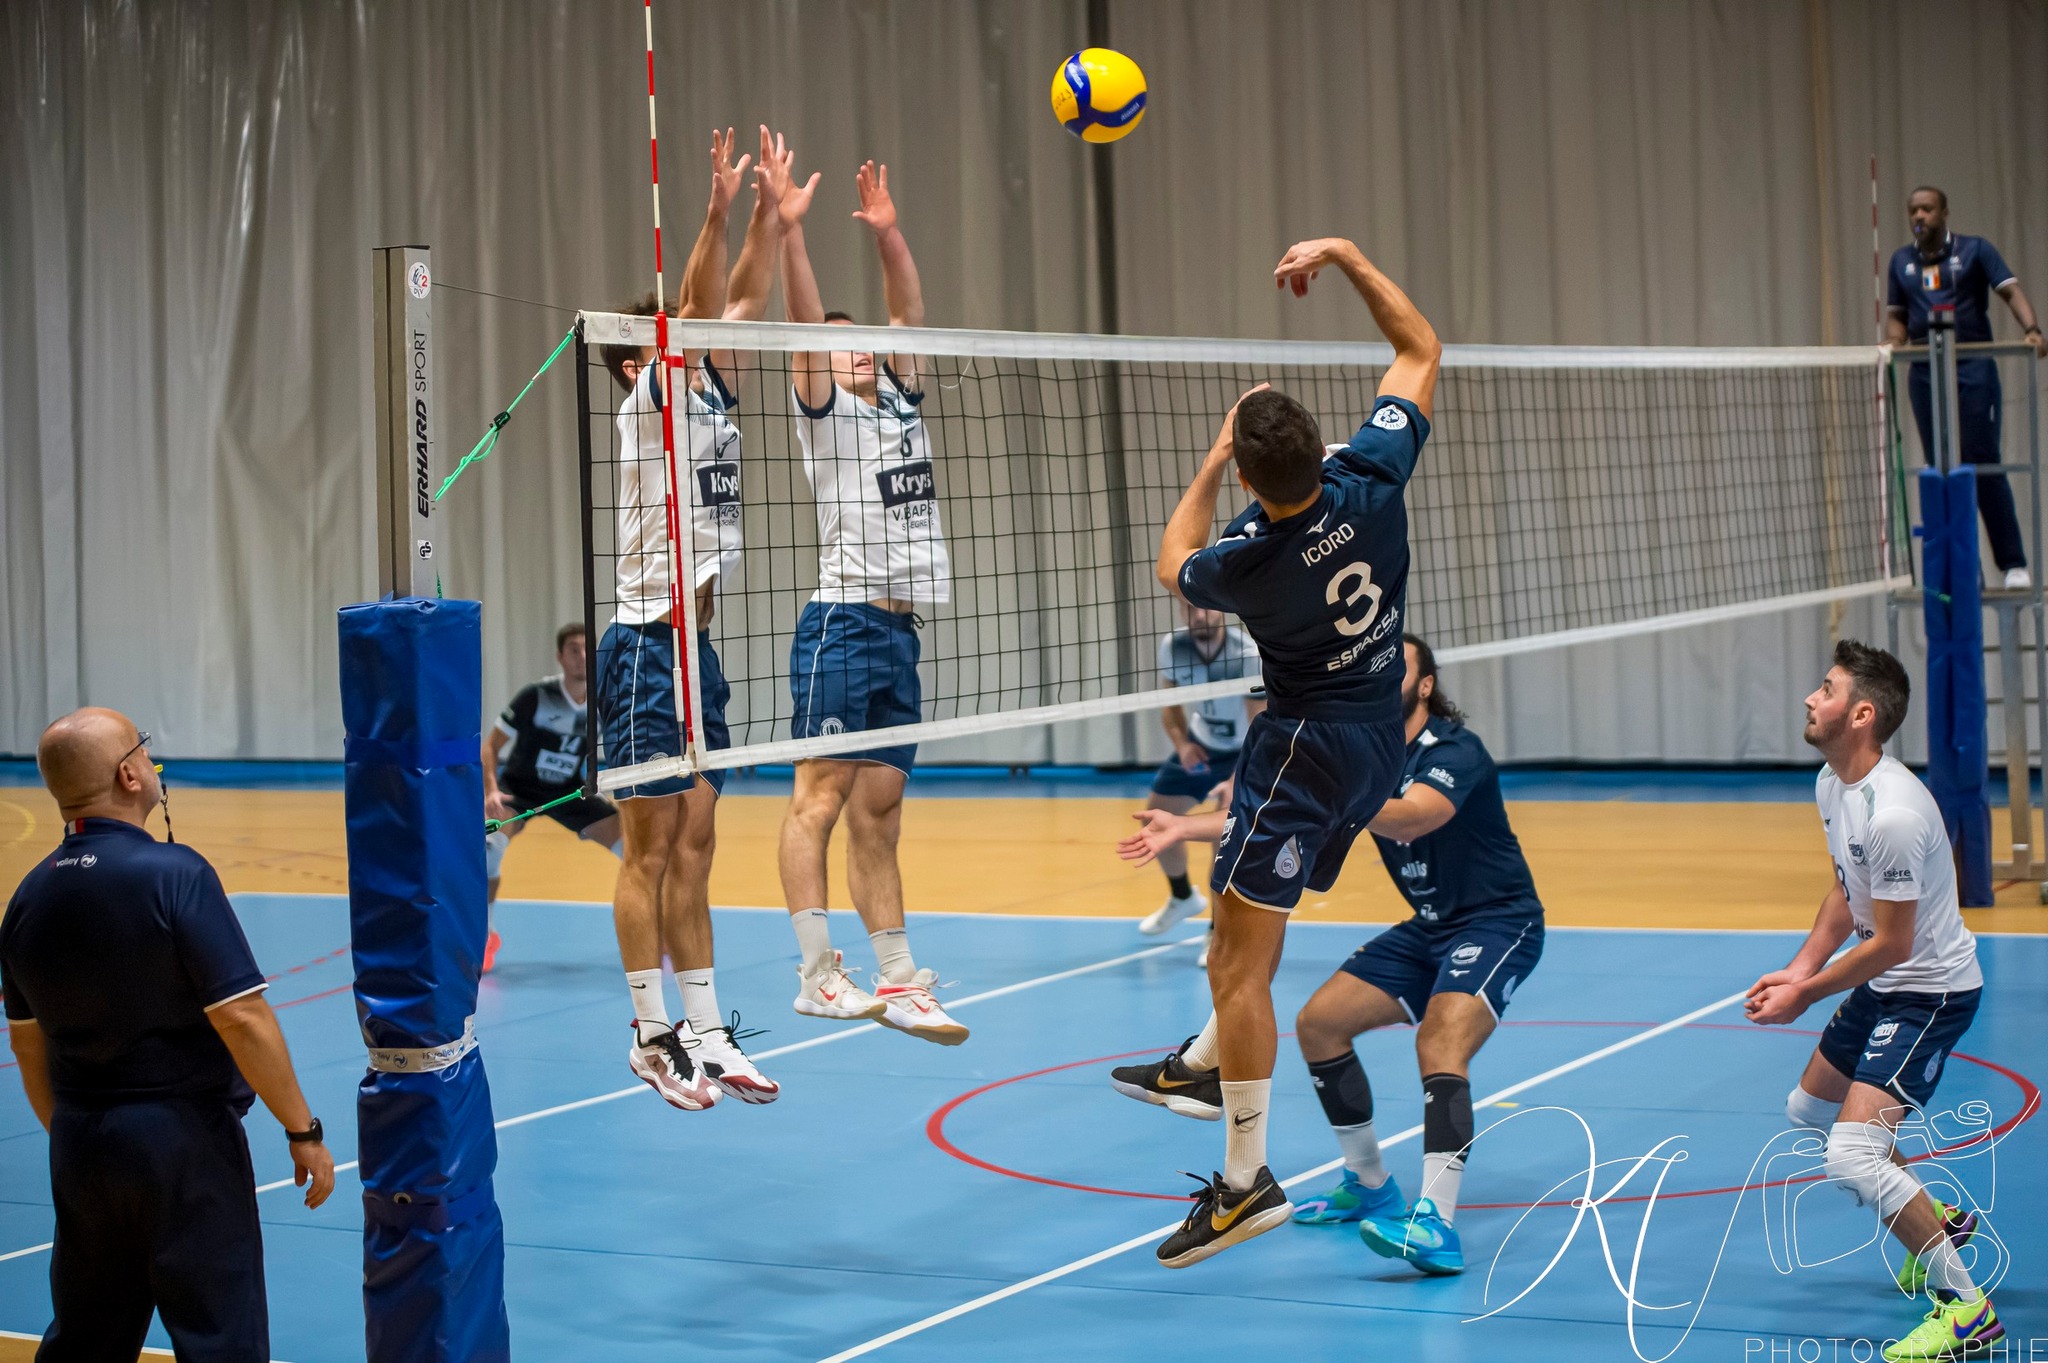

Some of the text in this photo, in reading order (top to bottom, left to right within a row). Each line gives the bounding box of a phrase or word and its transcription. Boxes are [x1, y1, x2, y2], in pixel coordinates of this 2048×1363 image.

[414, 329, 430, 518] ERHARD SPORT
[891, 472, 931, 495] Krys
[1301, 522, 1355, 567] ICORD
[1325, 561, 1383, 636] 3
[1883, 867, 1911, 878] isère
